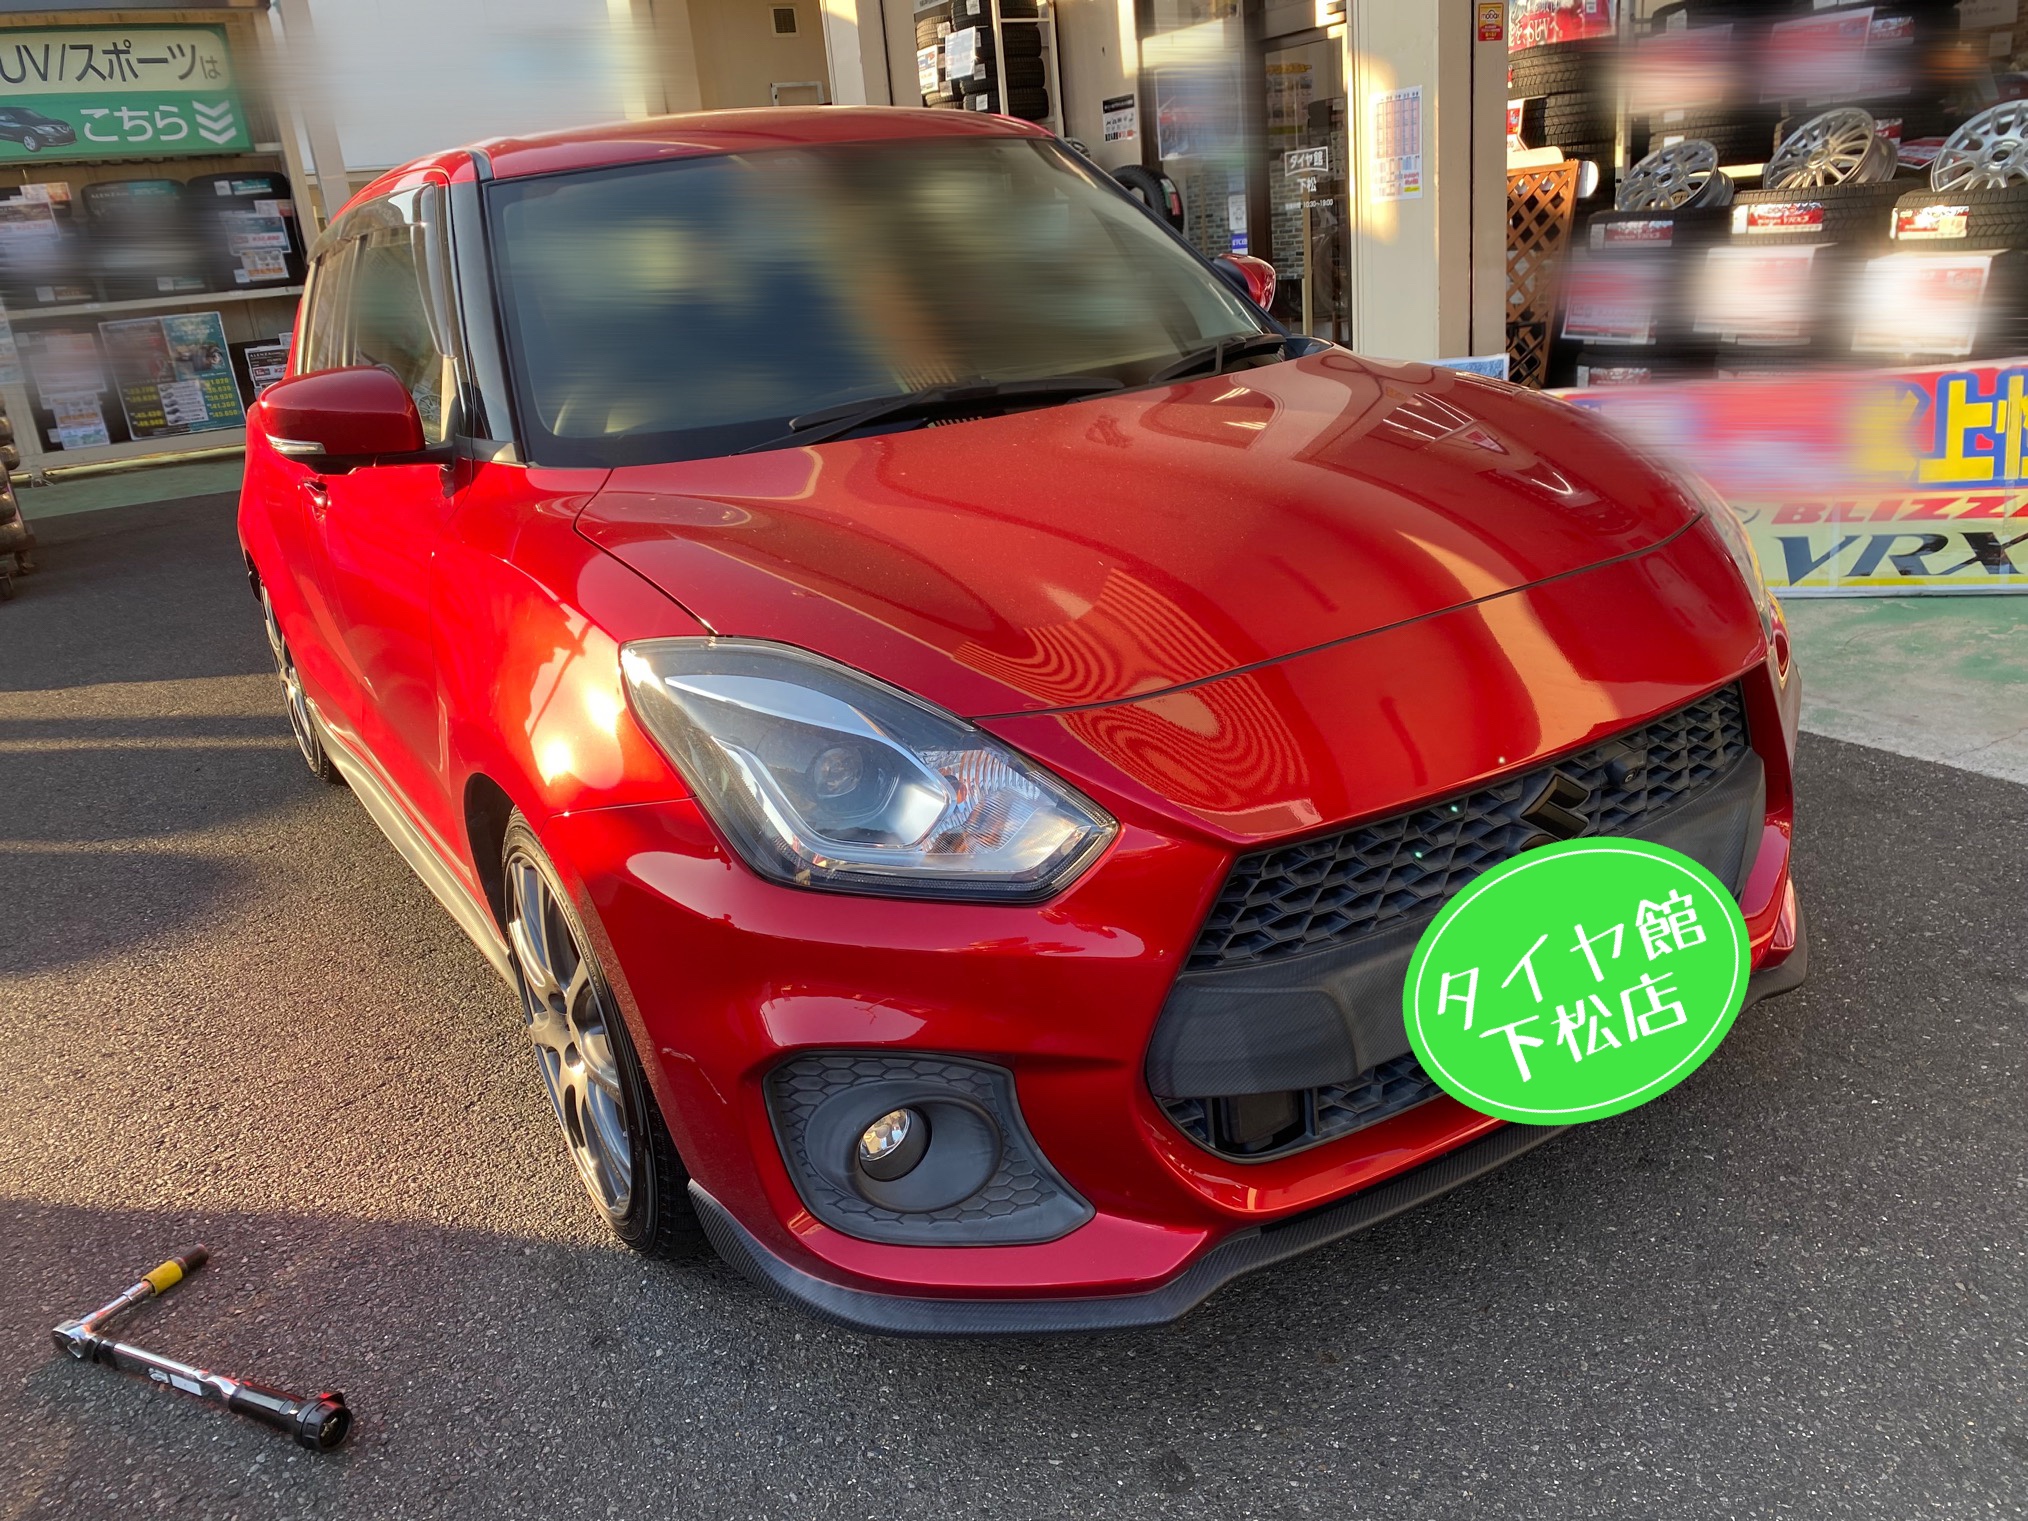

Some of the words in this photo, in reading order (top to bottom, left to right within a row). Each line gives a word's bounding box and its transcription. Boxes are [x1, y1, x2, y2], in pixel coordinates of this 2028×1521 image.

[80, 105, 188, 142] こちら
[1290, 151, 1324, 169] タイヤ館
[1297, 177, 1317, 193] 下松
[1773, 531, 2028, 586] VRX
